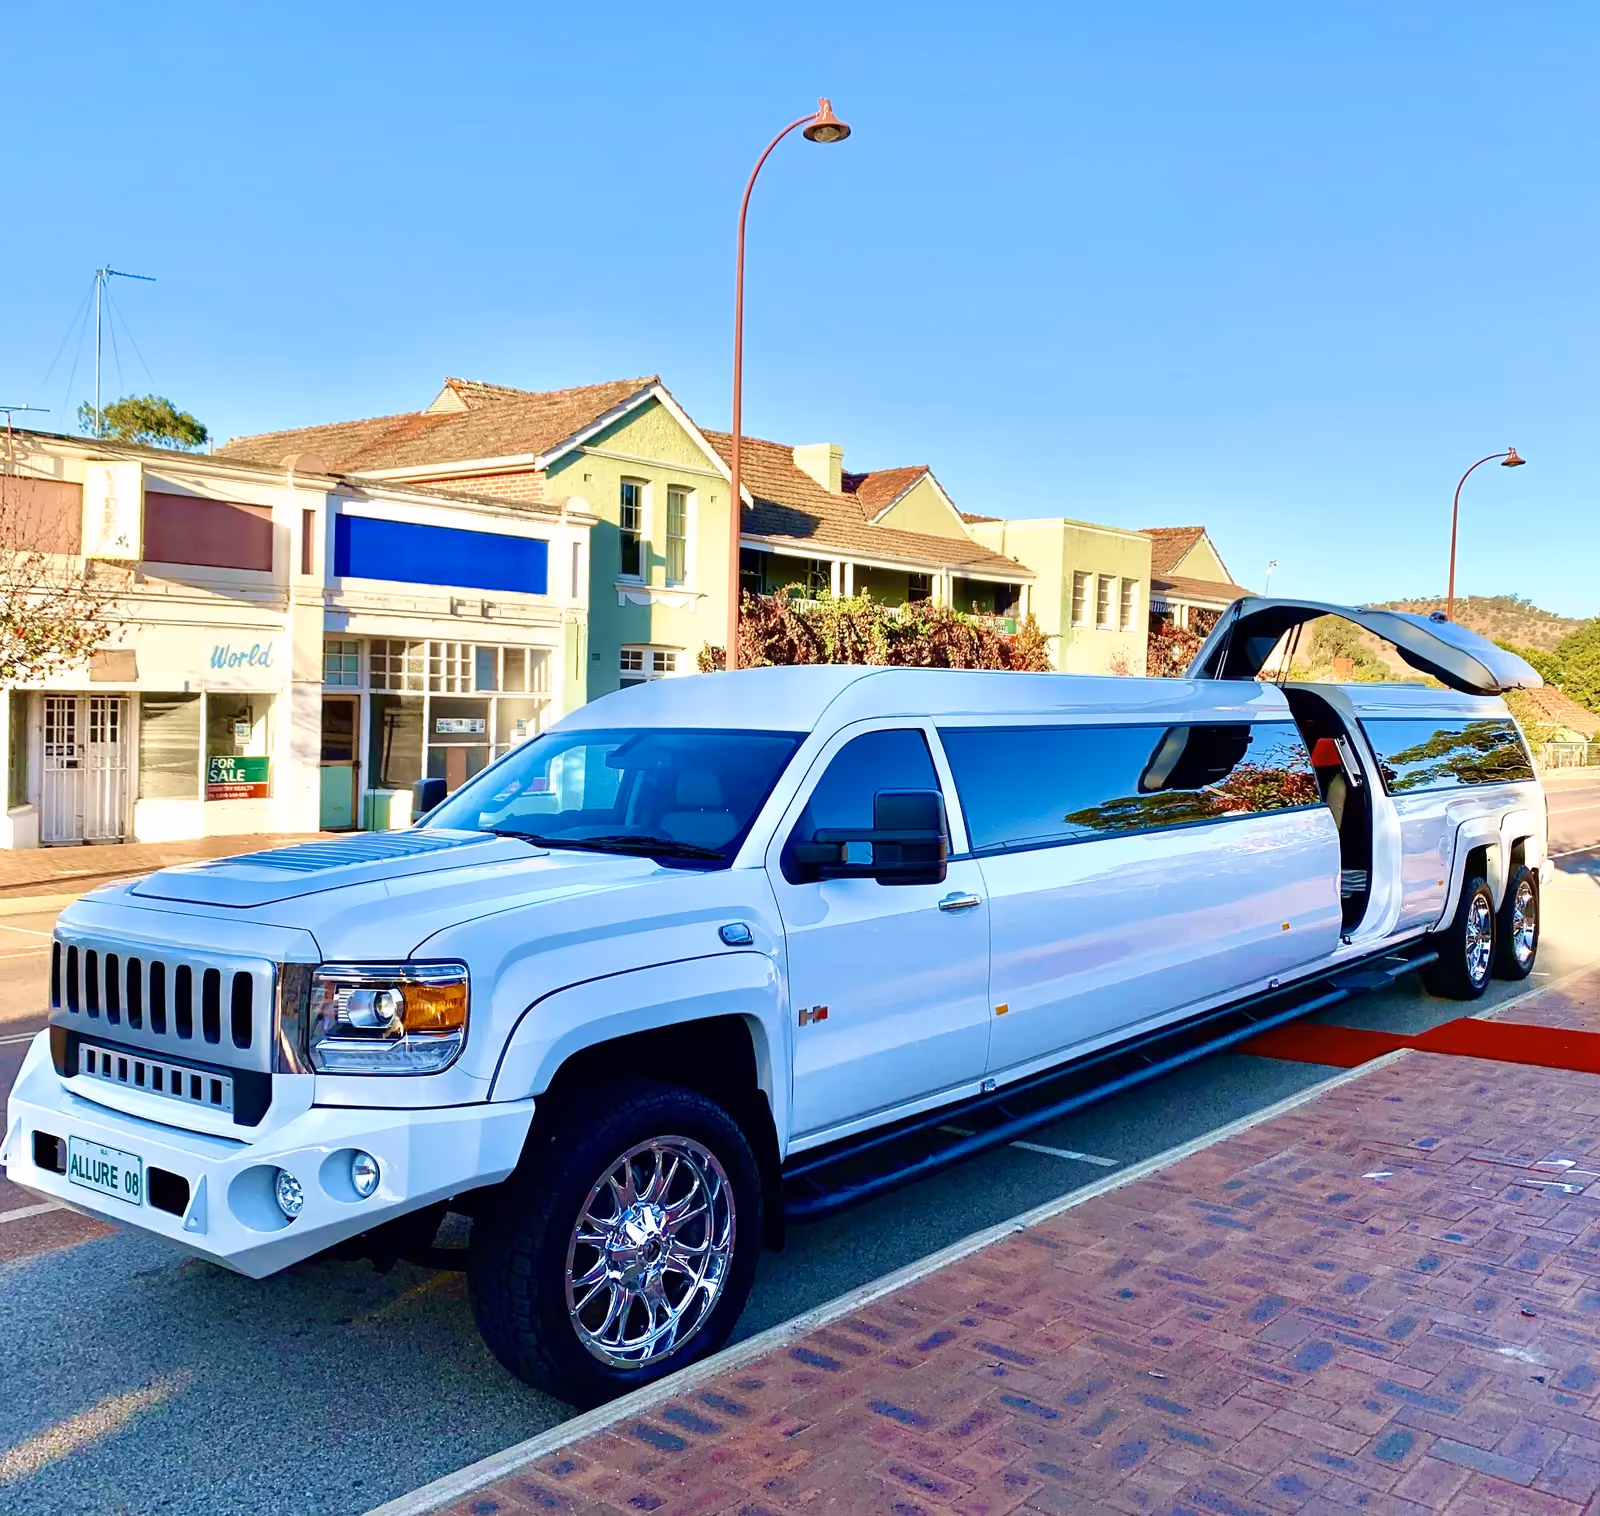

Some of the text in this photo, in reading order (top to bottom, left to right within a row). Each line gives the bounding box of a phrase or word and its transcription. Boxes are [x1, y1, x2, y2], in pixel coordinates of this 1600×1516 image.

[210, 641, 274, 669] World
[211, 758, 235, 769] FOR
[209, 769, 246, 782] SALE
[71, 1153, 139, 1196] ALLURE 08
